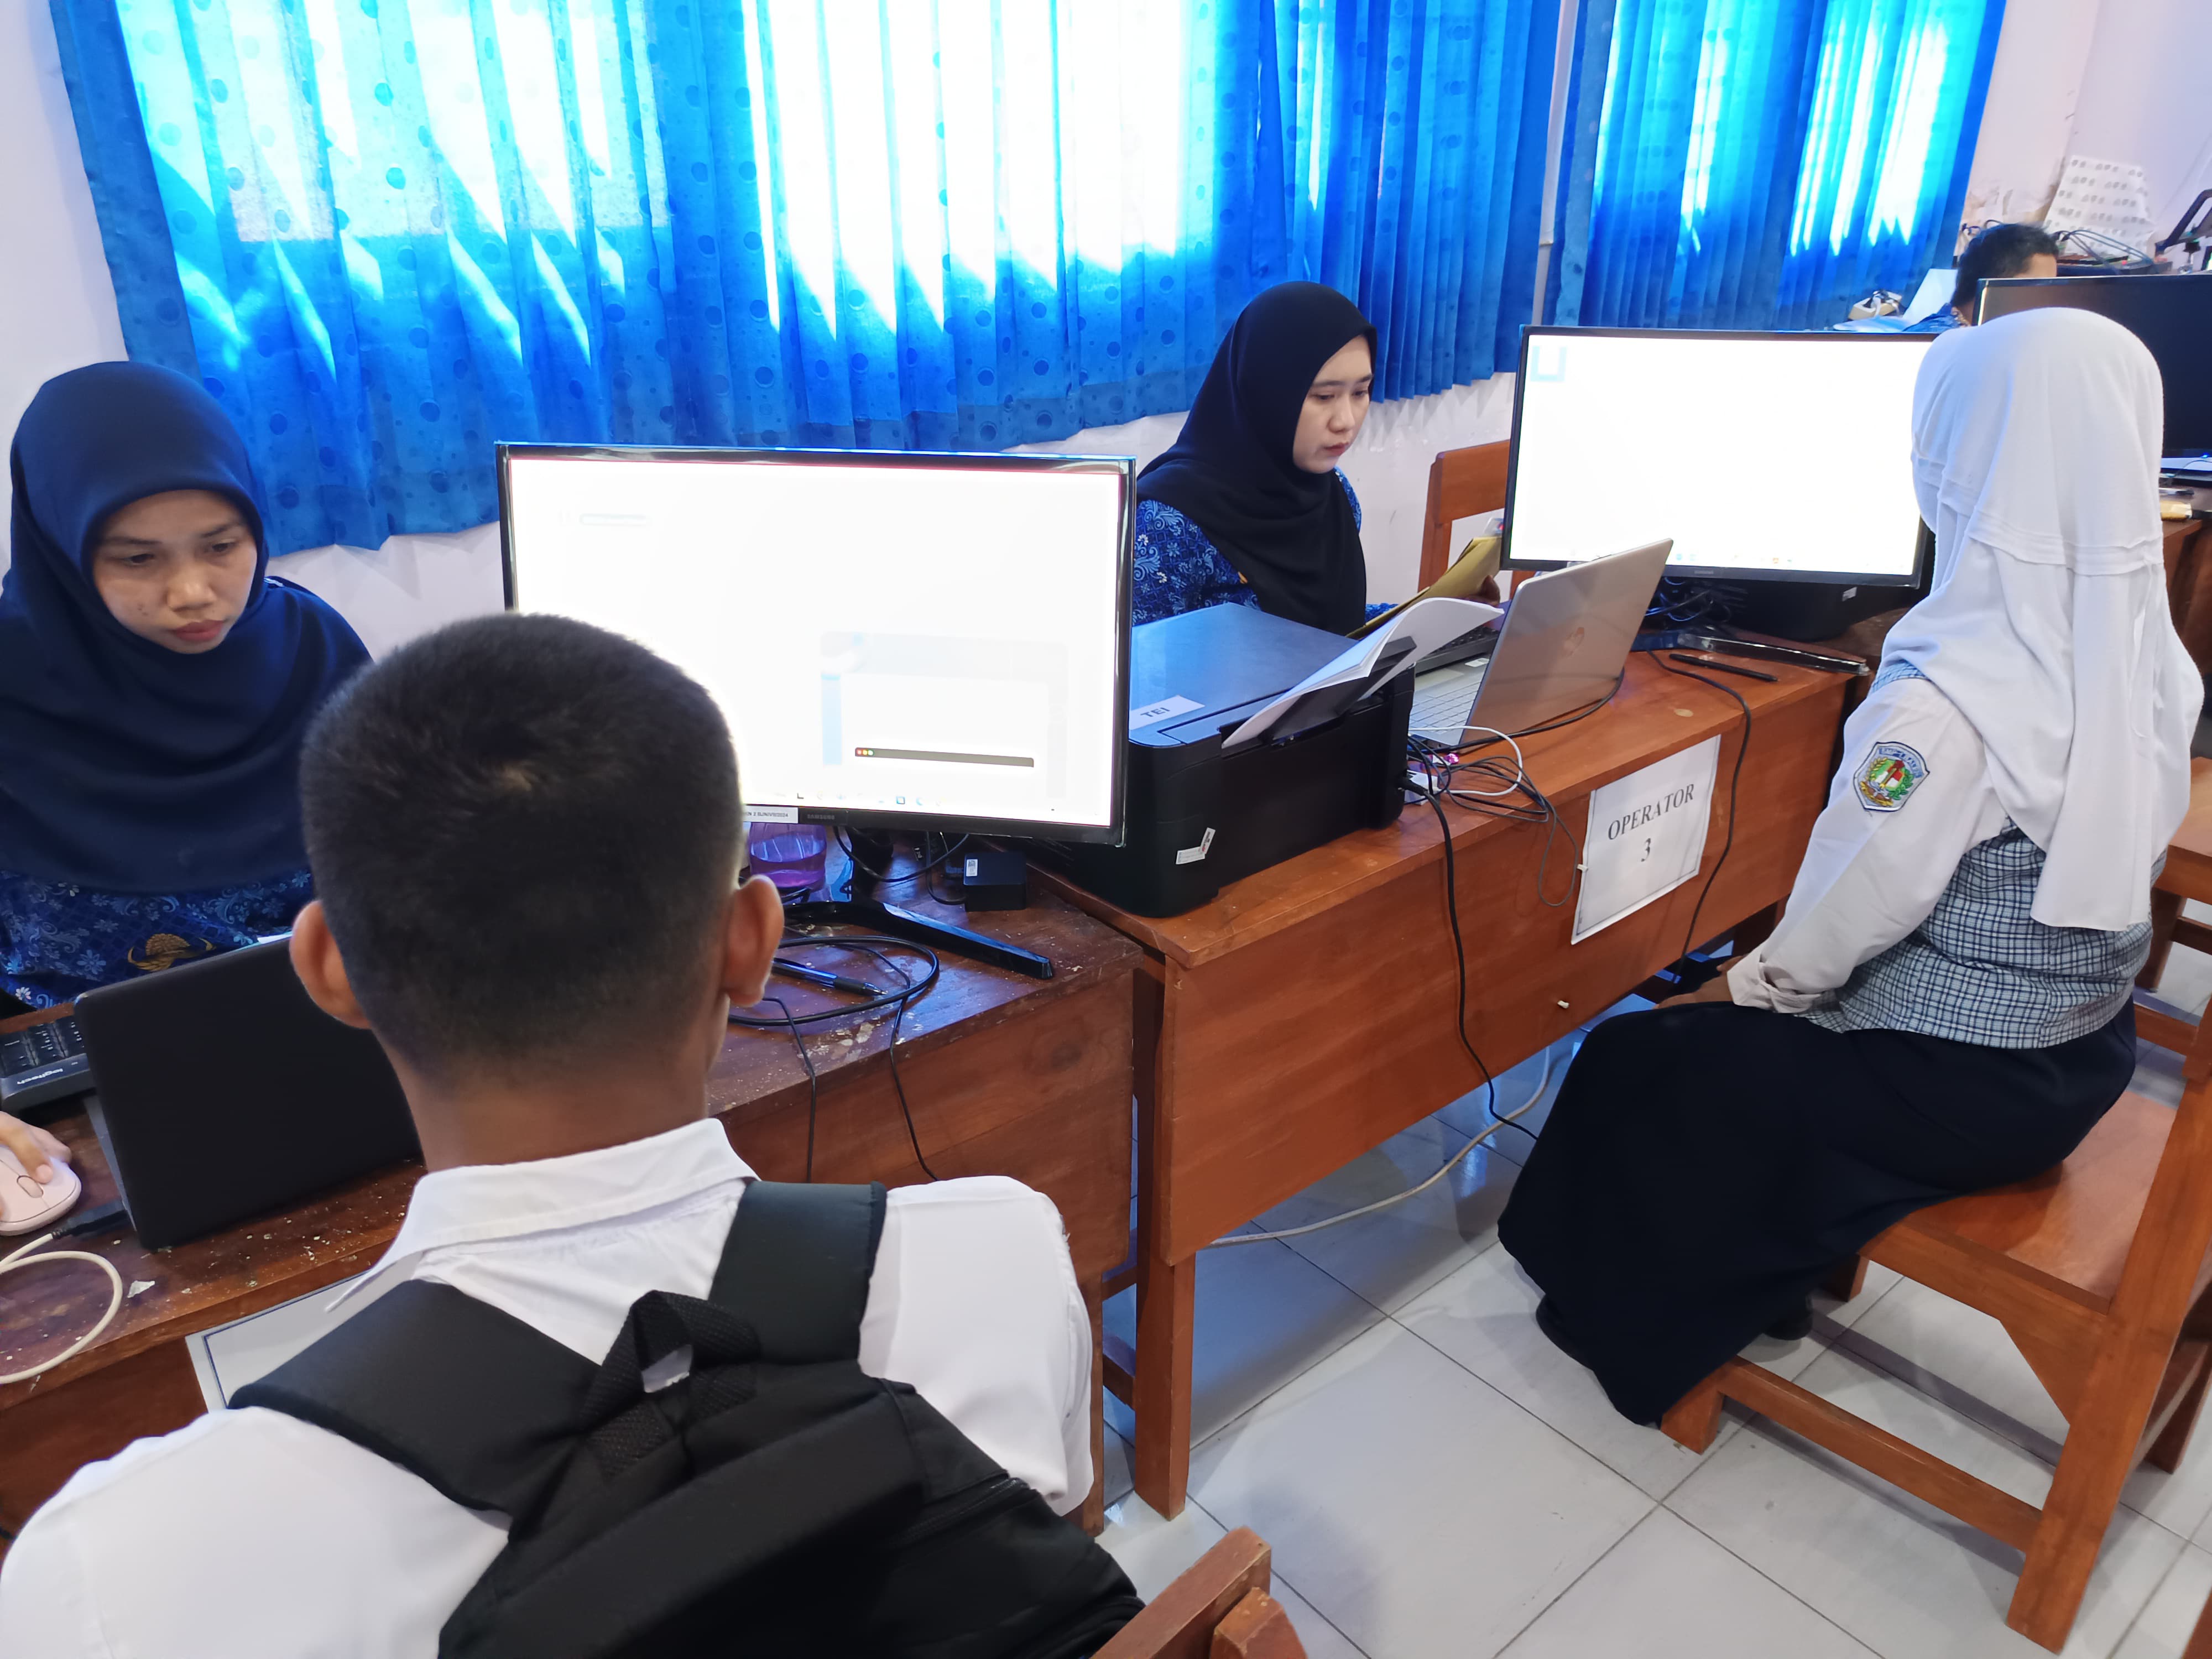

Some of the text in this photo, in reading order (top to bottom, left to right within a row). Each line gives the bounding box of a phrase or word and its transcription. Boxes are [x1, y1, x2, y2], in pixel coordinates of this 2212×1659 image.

[1140, 707, 1171, 718] TEI
[1608, 783, 1695, 841] OPERATOR
[1640, 838, 1652, 863] 3
[17, 1068, 63, 1084] logitech
